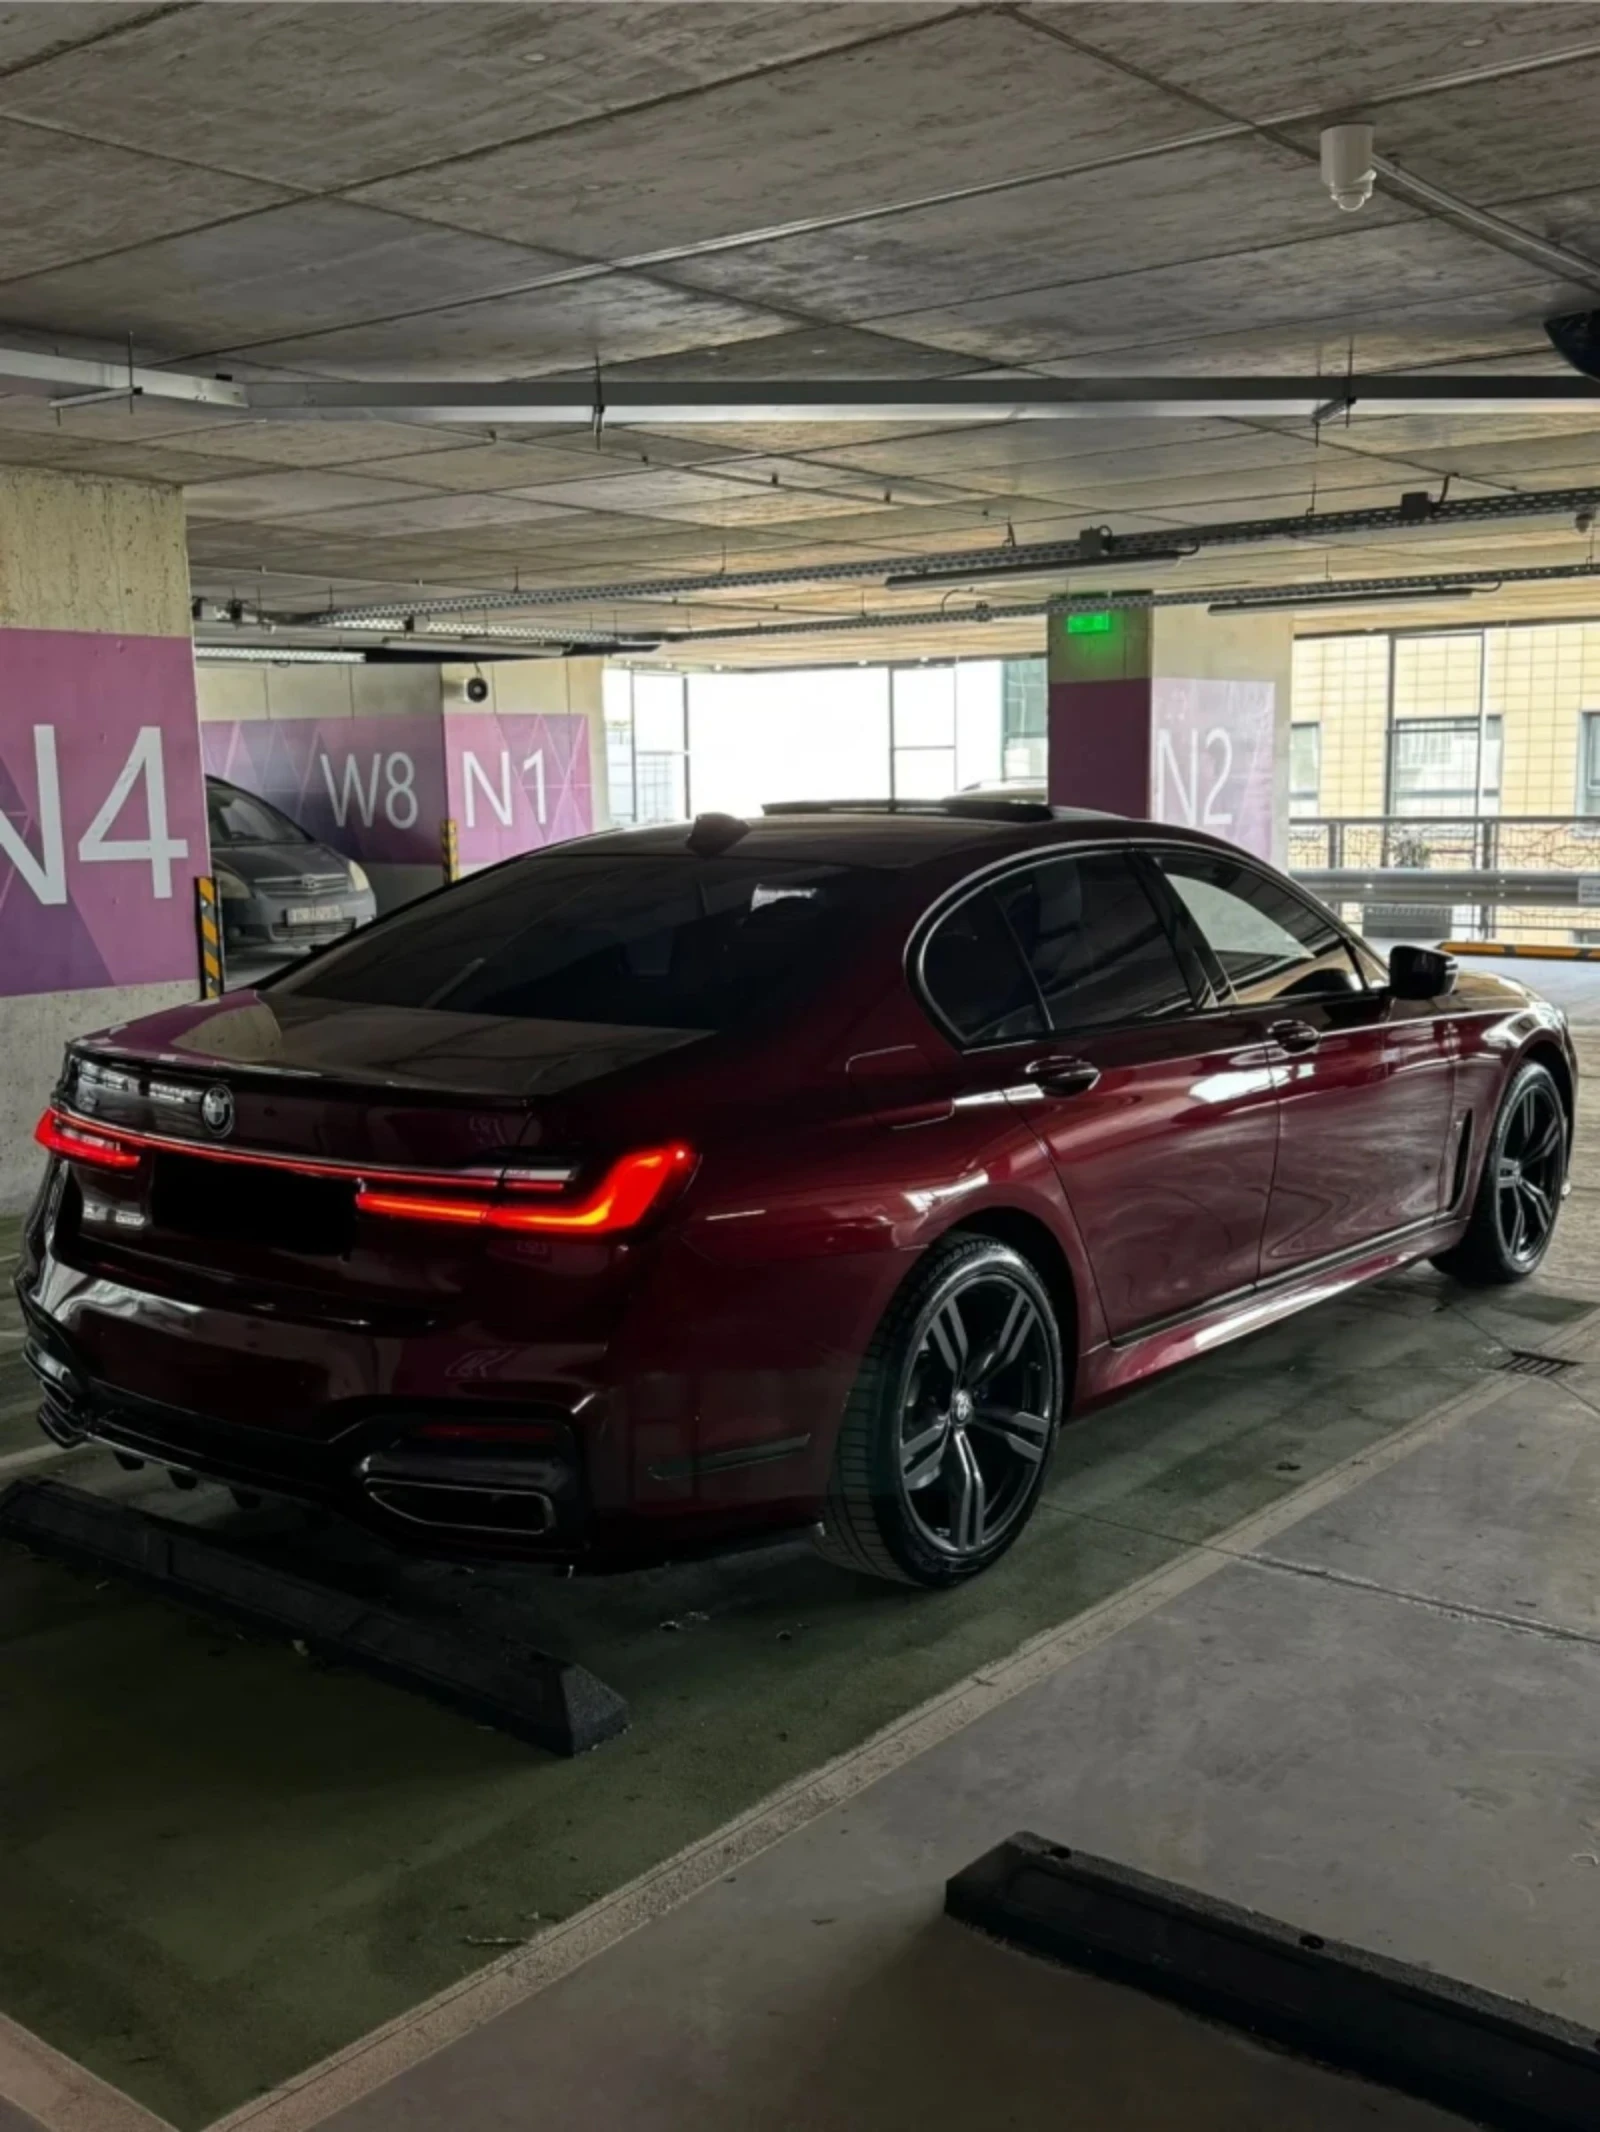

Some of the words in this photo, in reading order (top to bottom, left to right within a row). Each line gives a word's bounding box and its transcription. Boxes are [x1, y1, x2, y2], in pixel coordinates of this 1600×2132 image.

[320, 752, 418, 829] W8
[463, 749, 546, 828] N1
[1157, 727, 1233, 828] N2
